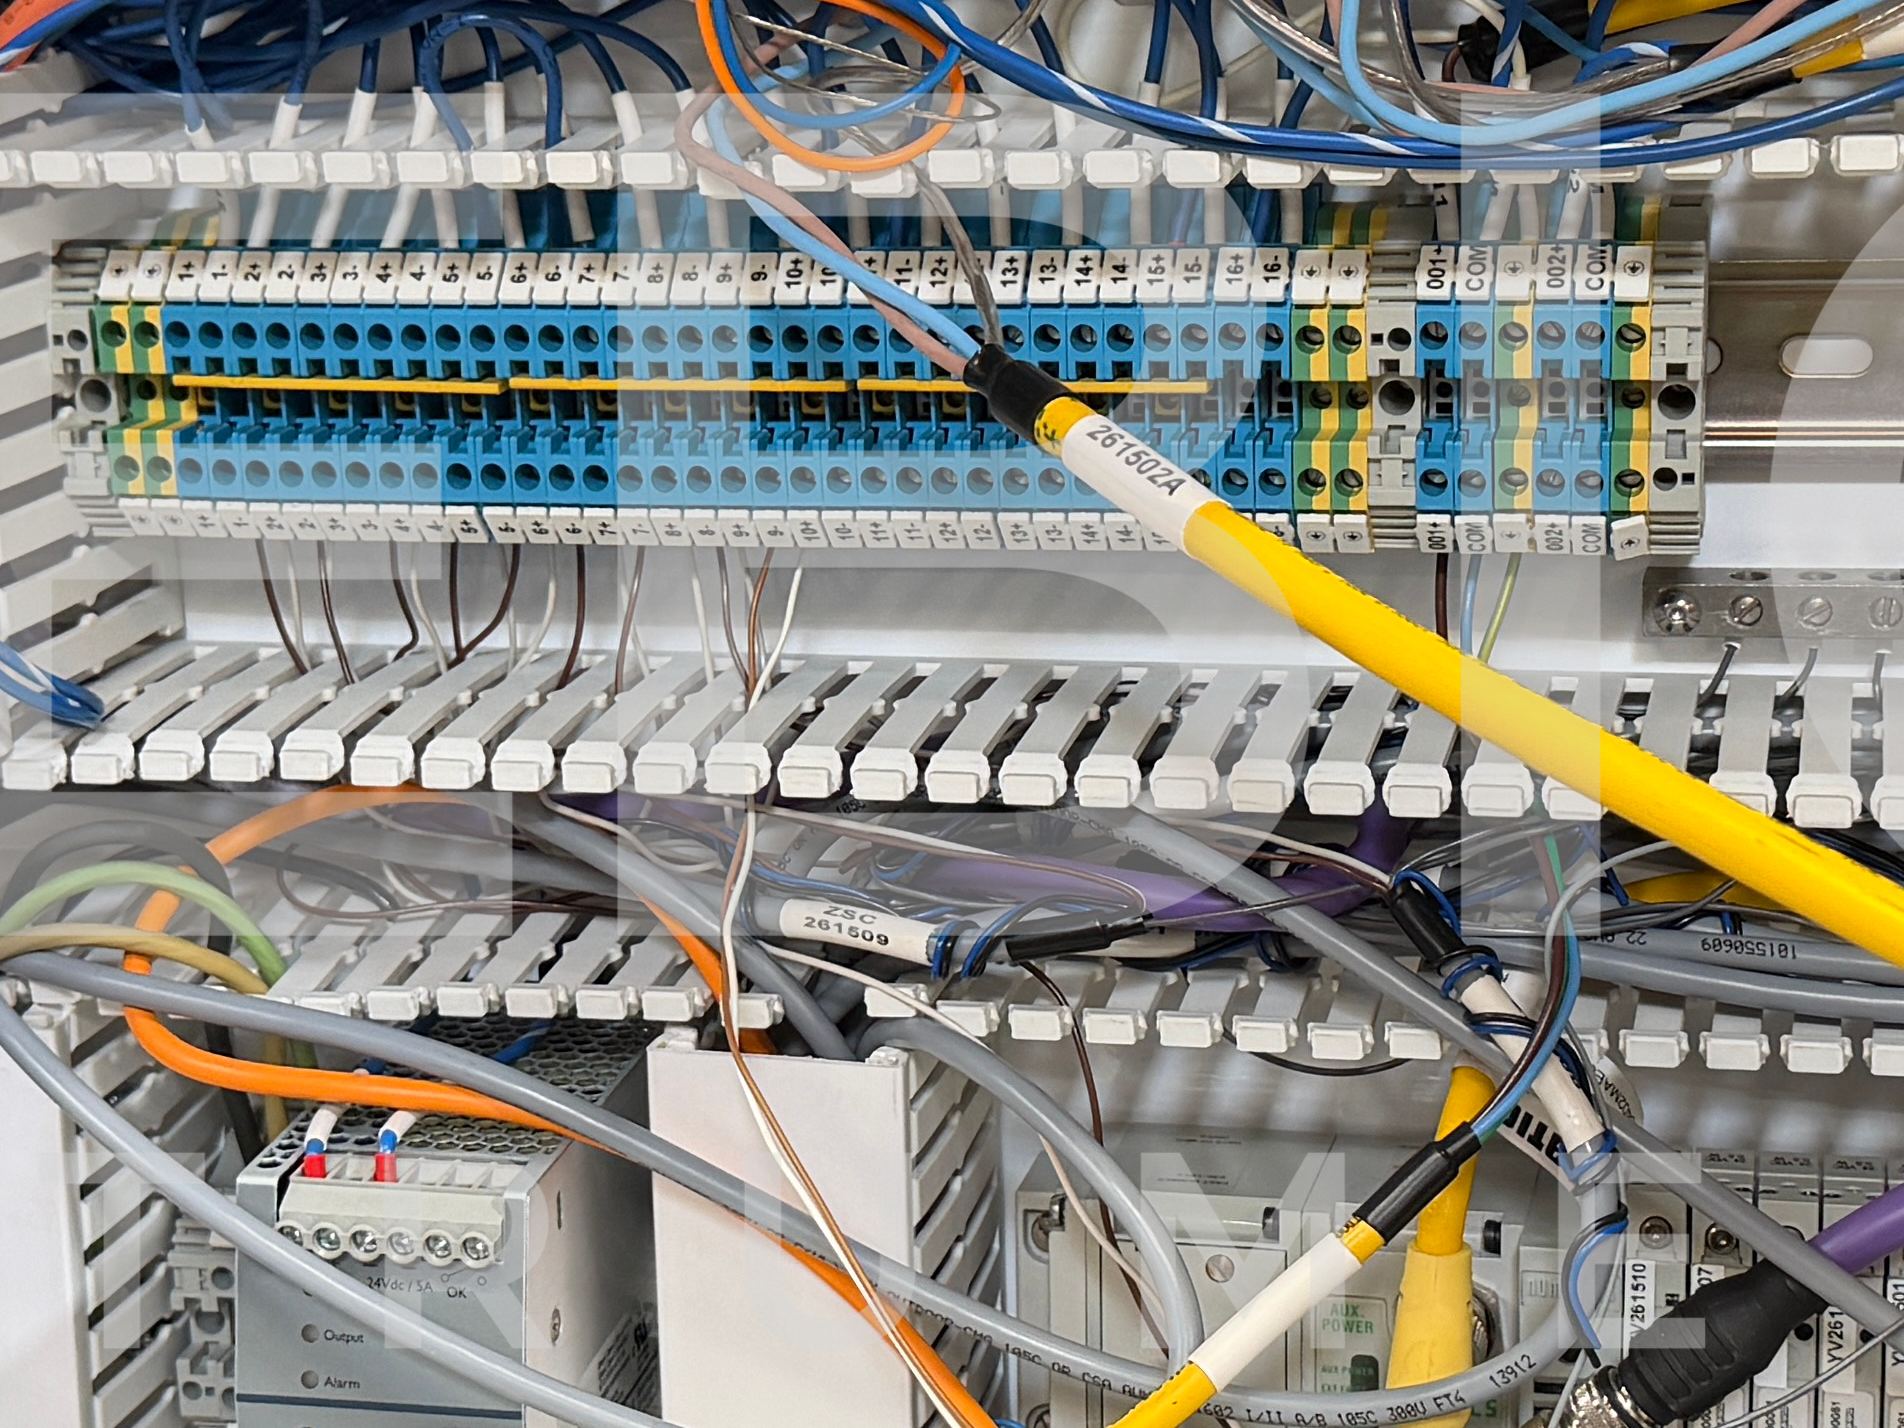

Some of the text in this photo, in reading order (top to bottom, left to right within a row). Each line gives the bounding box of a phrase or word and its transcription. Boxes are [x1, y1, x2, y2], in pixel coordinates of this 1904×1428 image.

[178, 262, 195, 283] 1+
[244, 262, 262, 283] 2+
[310, 262, 328, 283] 3+
[375, 262, 393, 284] 4+
[442, 262, 460, 284] 5+
[511, 262, 528, 285] 6+
[578, 262, 596, 284] 7+
[751, 262, 768, 282] 9-
[785, 257, 804, 289] 10+
[1039, 255, 1057, 286] 13-
[1076, 254, 1094, 287] 14+
[1226, 252, 1245, 286] 16+
[1263, 253, 1282, 285] 16-
[1466, 246, 1485, 292] COM
[1585, 246, 1608, 292] COM
[1086, 424, 1187, 496] 261502A
[821, 904, 877, 927] ZSC
[803, 916, 890, 946] 261509
[446, 1286, 467, 1299] OK
[1629, 1263, 1647, 1340] V261510
[324, 1329, 364, 1345] Output
[1322, 1319, 1374, 1334] POWER
[324, 1376, 360, 1389] Alarm
[1337, 1410, 1377, 1427] 105C
[1387, 1401, 1427, 1422] 300V
[1434, 1390, 1467, 1412] FT4
[1488, 1354, 1537, 1389] 13912
